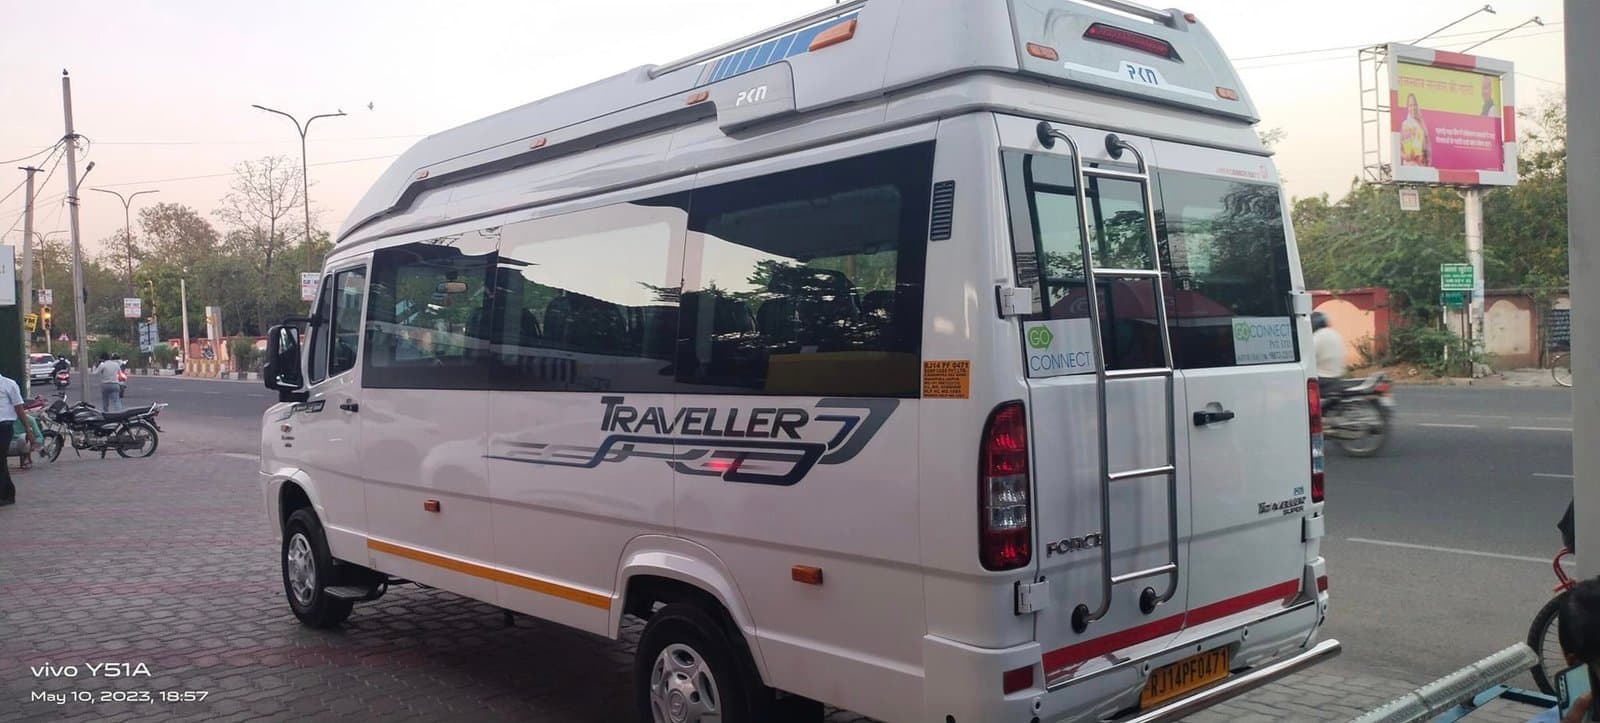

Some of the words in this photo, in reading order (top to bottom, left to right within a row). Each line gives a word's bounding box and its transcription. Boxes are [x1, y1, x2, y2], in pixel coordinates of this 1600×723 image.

[1030, 329, 1050, 346] GO
[1030, 352, 1090, 371] CONNECT
[600, 396, 809, 439] TRAVELLER
[1046, 533, 1104, 558] FORCE
[1151, 649, 1227, 697] RJ14PF0471
